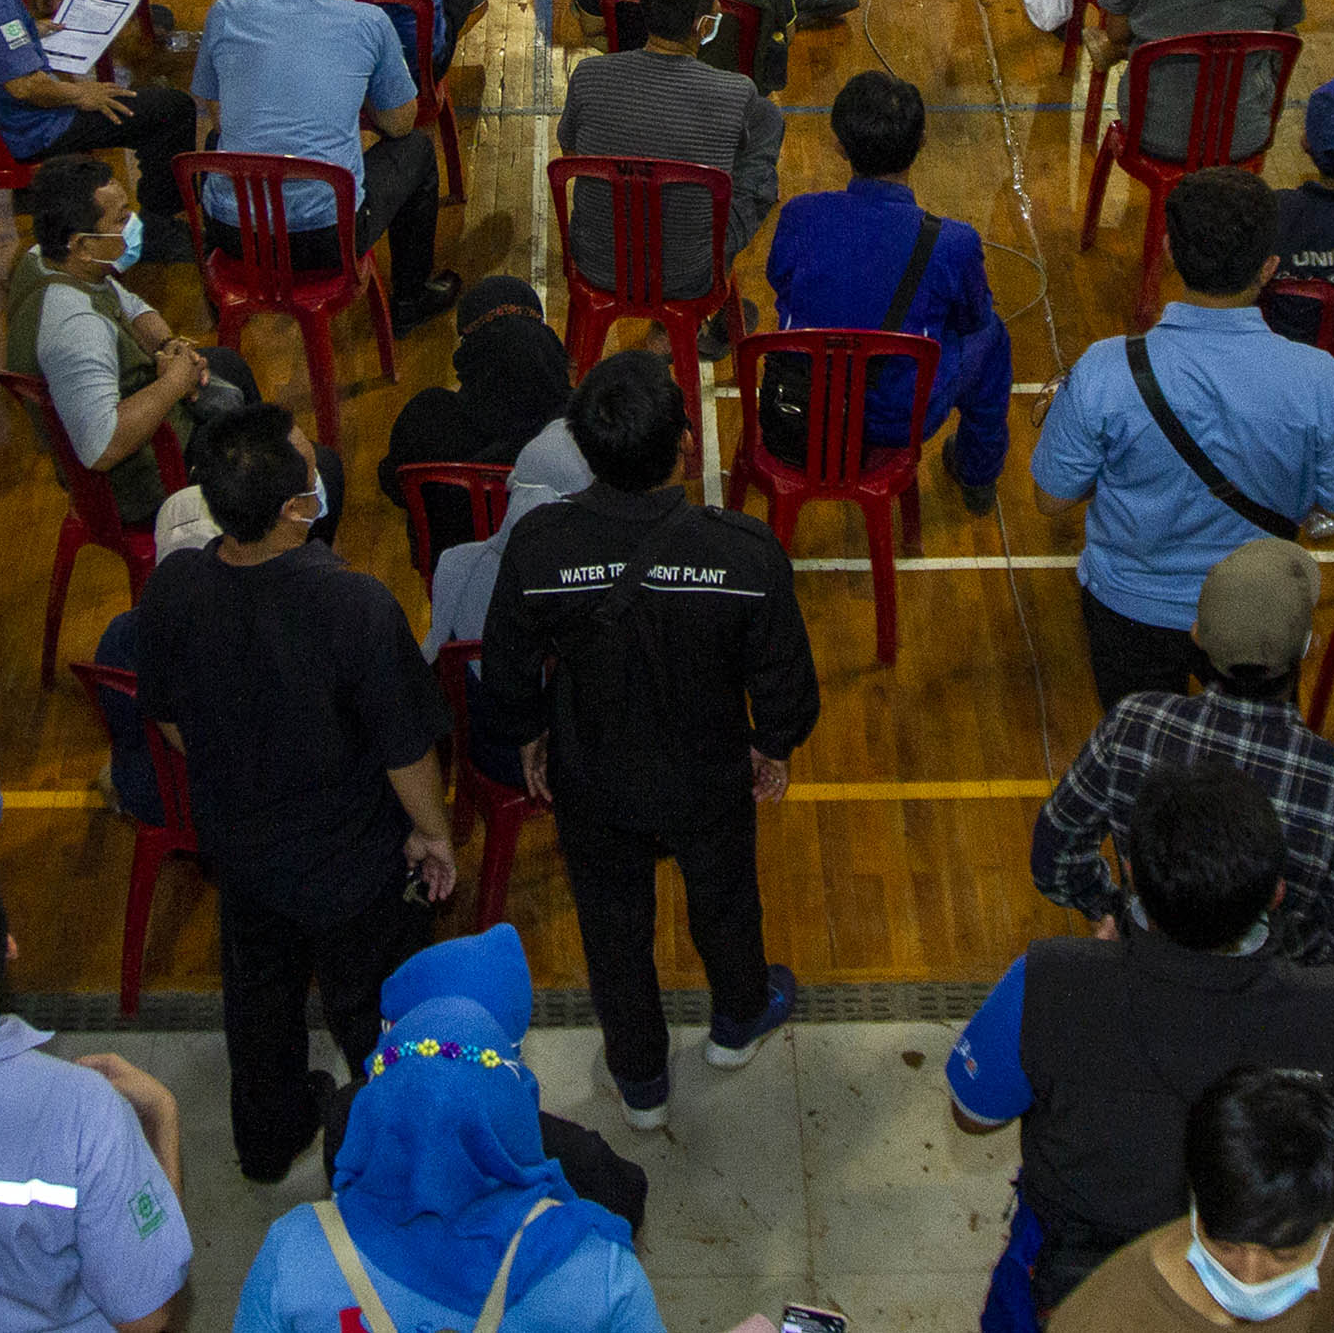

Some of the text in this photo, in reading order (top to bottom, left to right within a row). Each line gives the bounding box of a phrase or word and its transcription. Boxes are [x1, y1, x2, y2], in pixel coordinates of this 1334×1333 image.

[559, 562, 727, 585] WATER TRMENT PLANT
